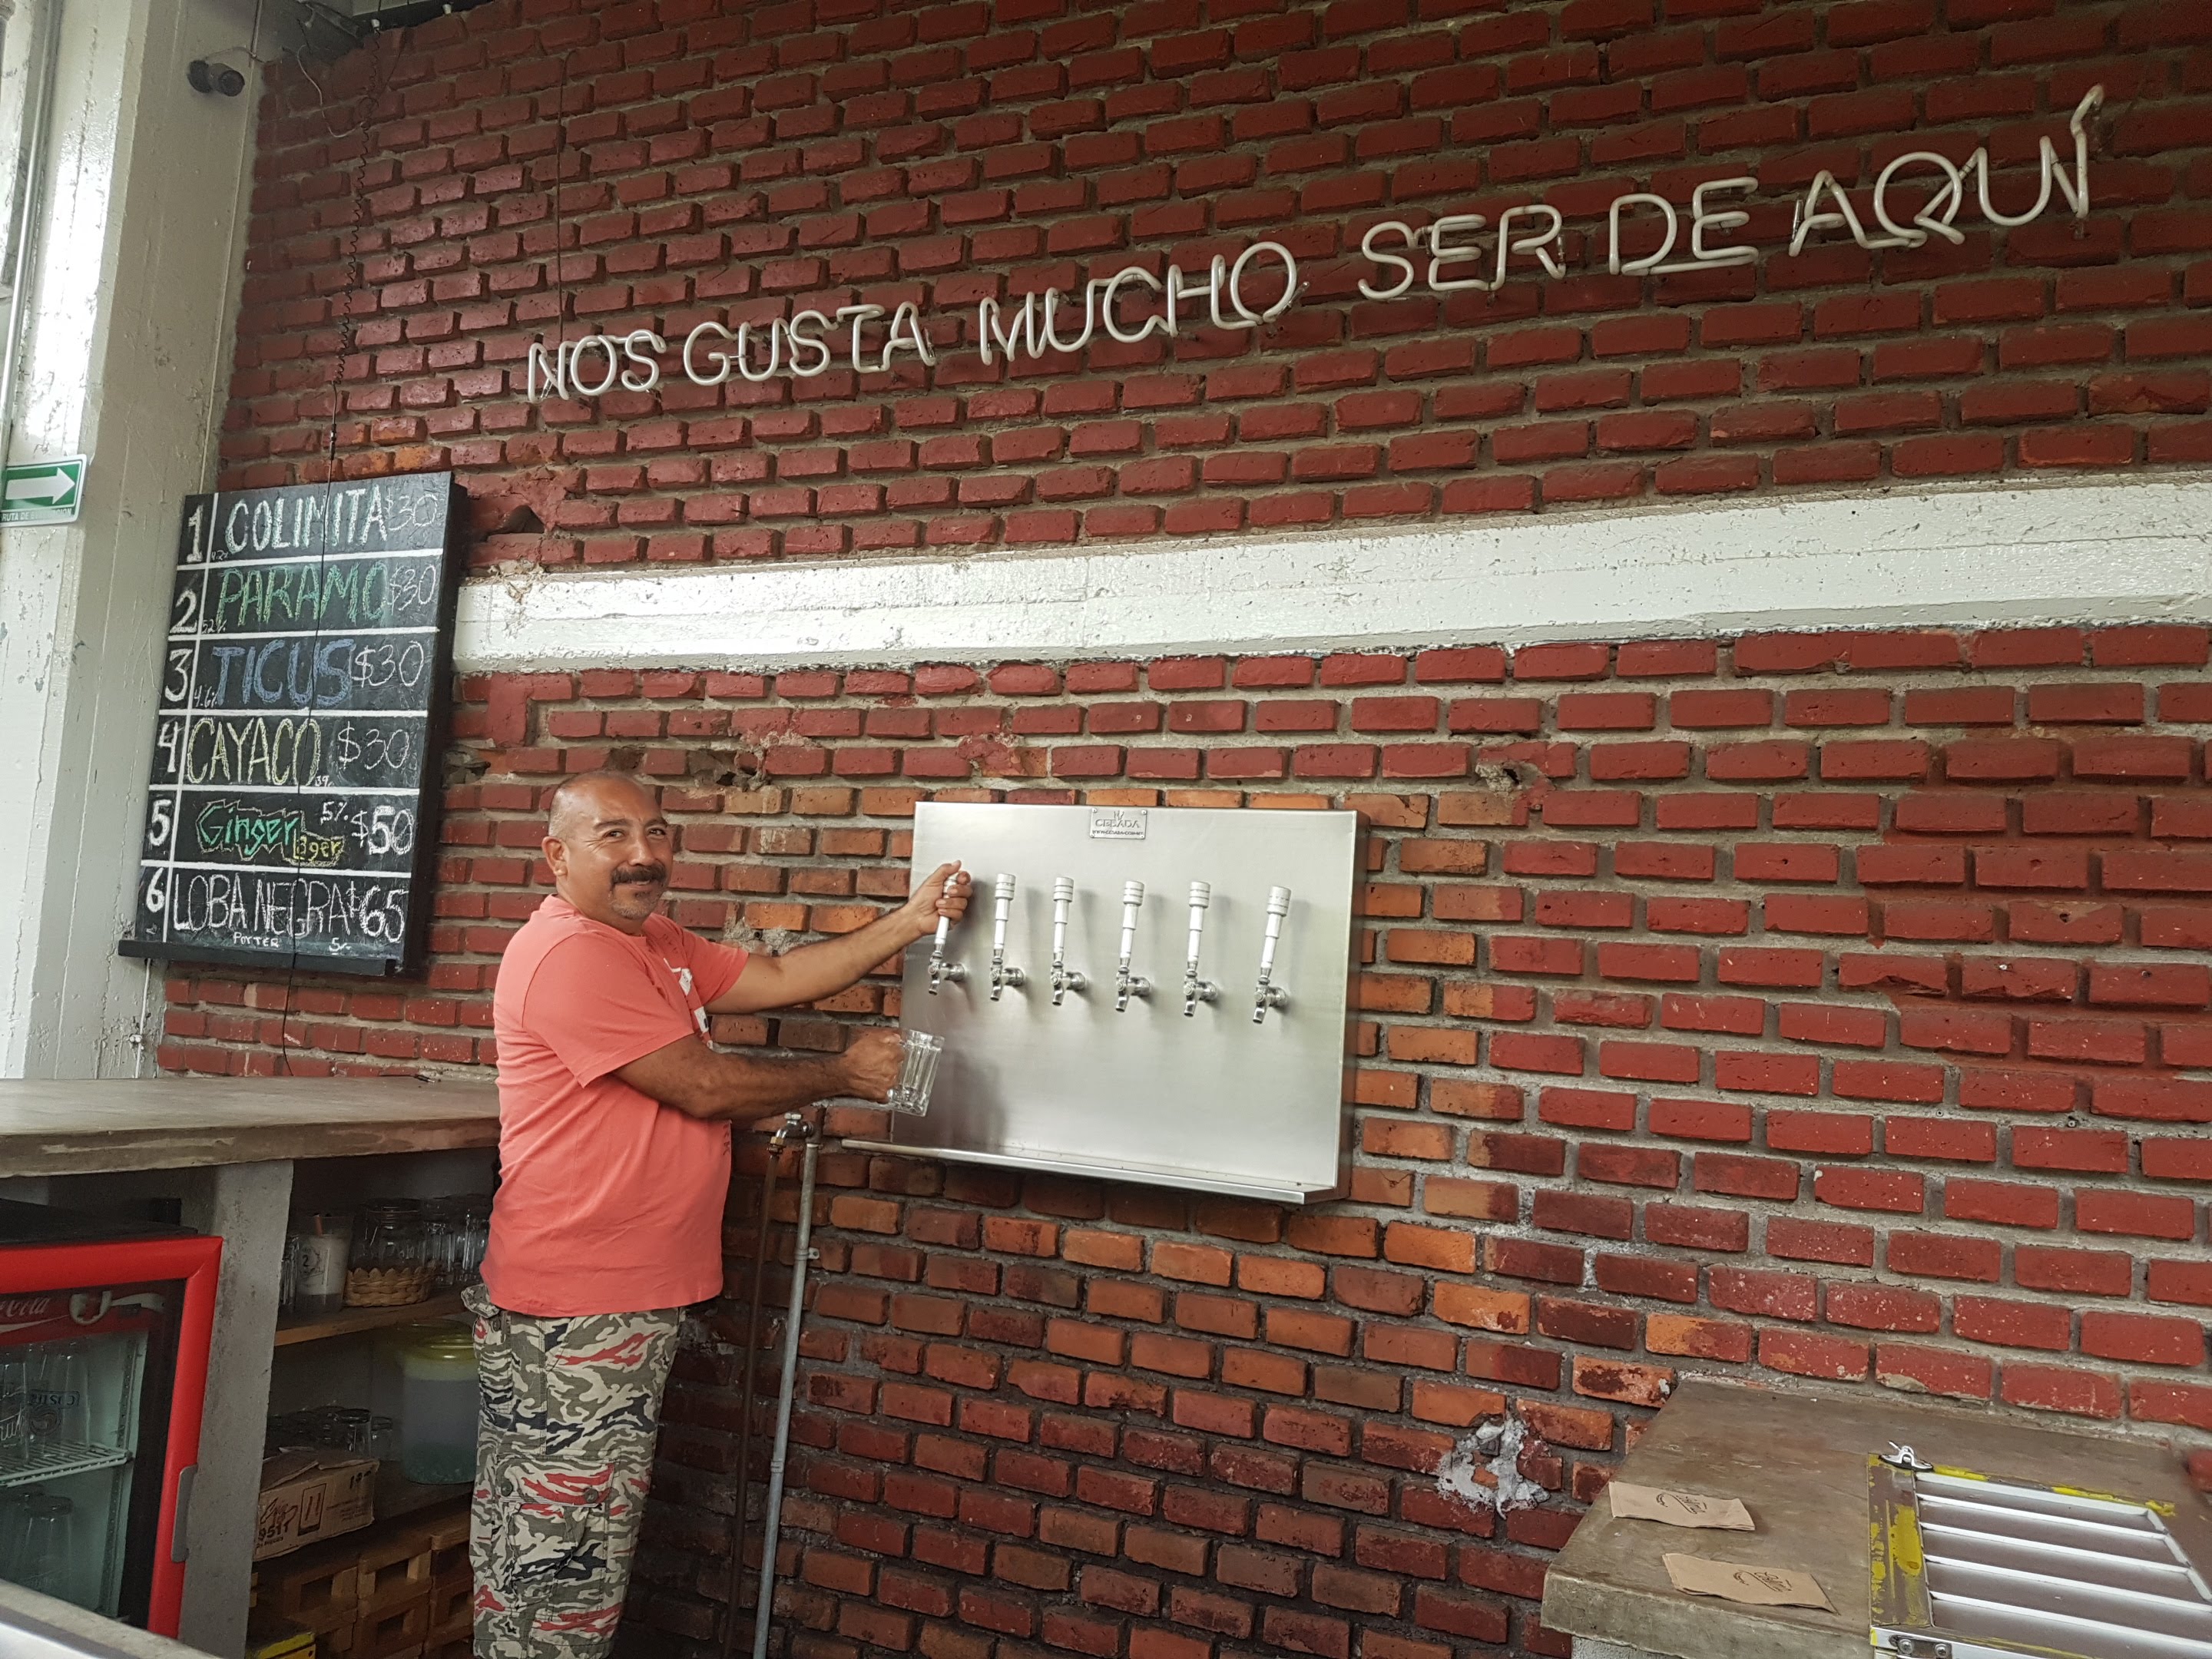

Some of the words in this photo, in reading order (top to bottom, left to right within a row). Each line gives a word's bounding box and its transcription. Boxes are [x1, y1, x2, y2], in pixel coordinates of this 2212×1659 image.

[528, 329, 667, 403] NOS
[683, 300, 936, 386] GUSTA
[979, 240, 1307, 366] MUCHO
[1358, 203, 1568, 300] SER
[1608, 176, 1759, 276] DE
[2, 512, 19, 522] RUTA
[20, 512, 30, 521] DE
[187, 503, 204, 563] 1
[225, 485, 387, 555] COLIMITA
[384, 487, 439, 531] $30
[170, 588, 198, 634] 2
[216, 560, 389, 628] PARAMO
[387, 561, 437, 616] $30
[164, 647, 194, 702] 3
[210, 638, 356, 708] TICUS
[352, 640, 425, 687] $30
[157, 718, 179, 773] 4
[186, 717, 322, 786] CAYACO
[338, 720, 410, 770] $30
[149, 799, 173, 847] 5
[198, 803, 300, 857] Ginger
[349, 805, 415, 856] $50
[146, 867, 165, 913] 6
[173, 872, 247, 932] LOBA
[253, 879, 351, 939] NEGRA
[345, 880, 409, 944] $65
